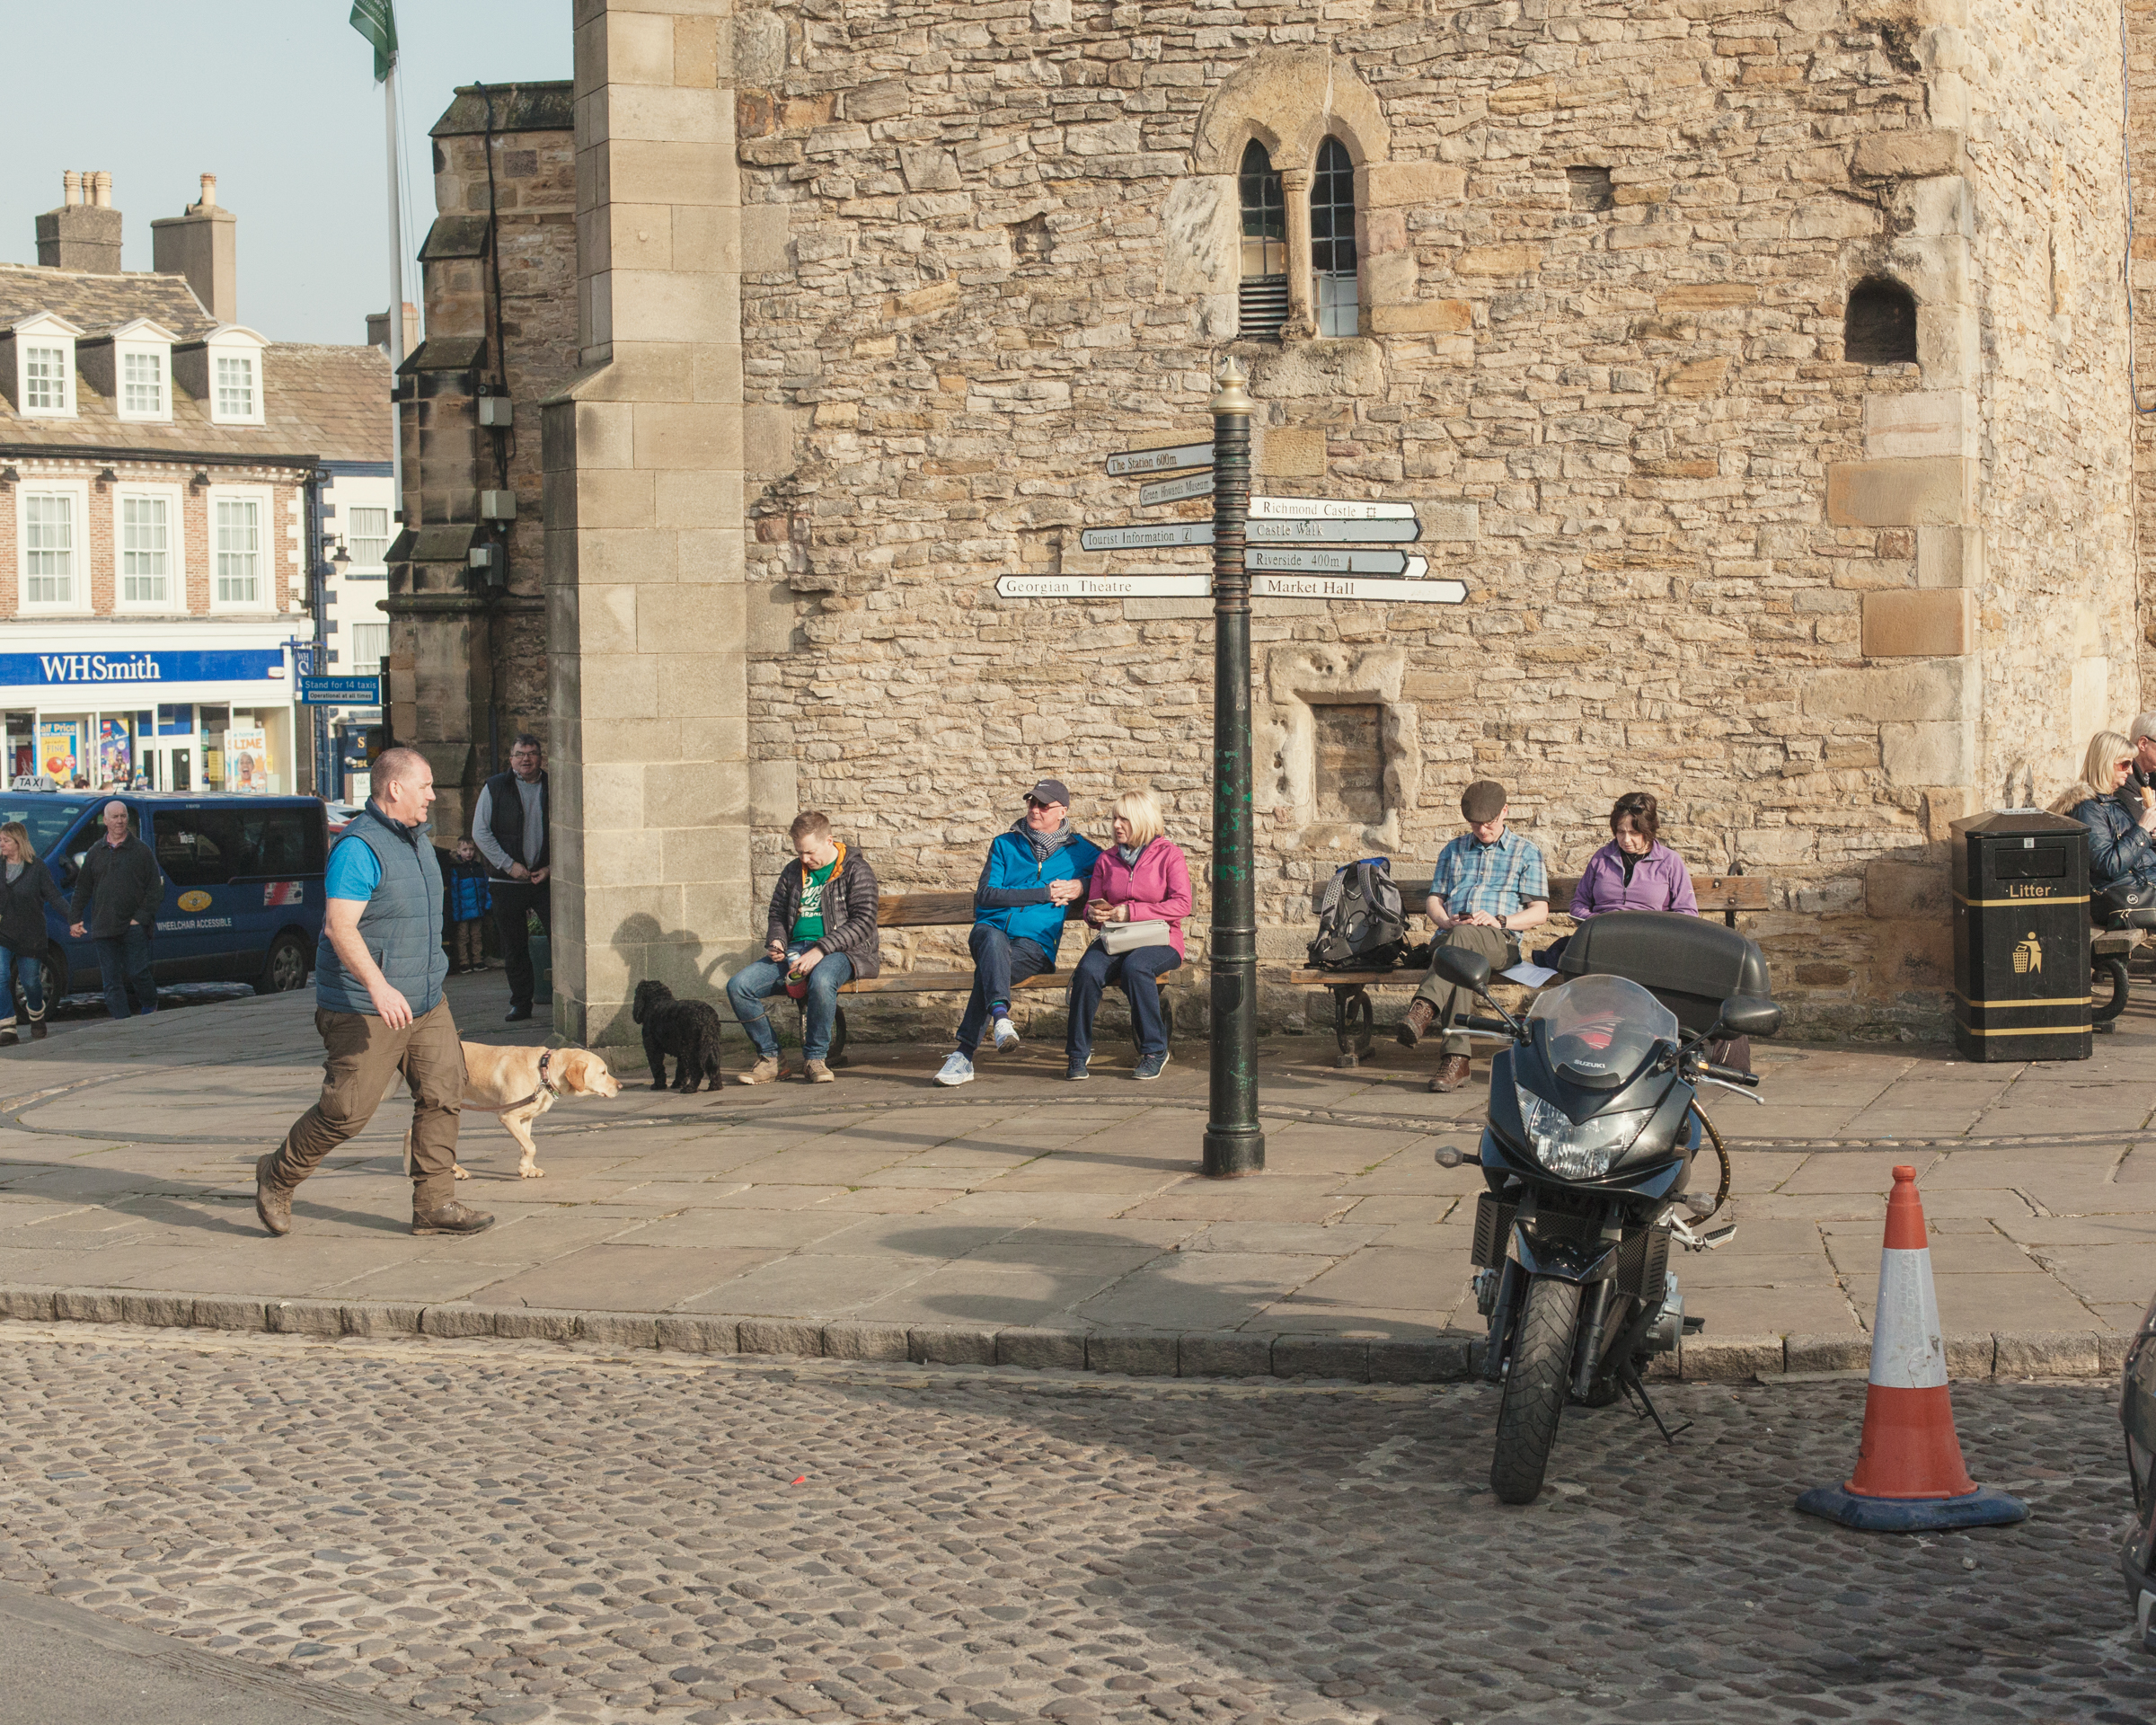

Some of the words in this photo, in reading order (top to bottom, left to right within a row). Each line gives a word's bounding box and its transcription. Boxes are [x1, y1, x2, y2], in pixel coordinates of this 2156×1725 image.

[1111, 457, 1126, 472] The
[1127, 456, 1153, 470] Station
[1156, 454, 1178, 465] 600m
[1143, 488, 1159, 501] Green
[1161, 484, 1184, 498] Howards
[1185, 479, 1209, 492] Museum
[1263, 501, 1318, 516] Richmond
[1323, 503, 1356, 517] Castle
[1258, 523, 1292, 536] Castle
[1296, 522, 1324, 536] Walk
[1087, 533, 1118, 545] Tourist
[1122, 530, 1174, 544] Information
[1256, 553, 1302, 567] Riverside
[1311, 554, 1340, 567] 400m
[1006, 579, 1069, 595] Georgian
[1078, 579, 1132, 592] Theatre
[1268, 579, 1318, 594] Market
[1323, 581, 1355, 595] Hall
[297, 652, 309, 660] WH
[40, 654, 161, 682] WHSmith
[305, 680, 329, 689] Stand
[331, 680, 342, 688] for
[346, 680, 355, 688] 14
[358, 680, 377, 689] taxis
[54, 723, 75, 733] Price
[47, 745, 65, 753] FING
[20, 777, 43, 787] TAXI
[2010, 884, 2052, 898] Litter
[156, 919, 196, 931] WHEELCHAIR
[196, 917, 233, 929] ACCESSIBLE
[1574, 1059, 1606, 1069] SUZUKI
